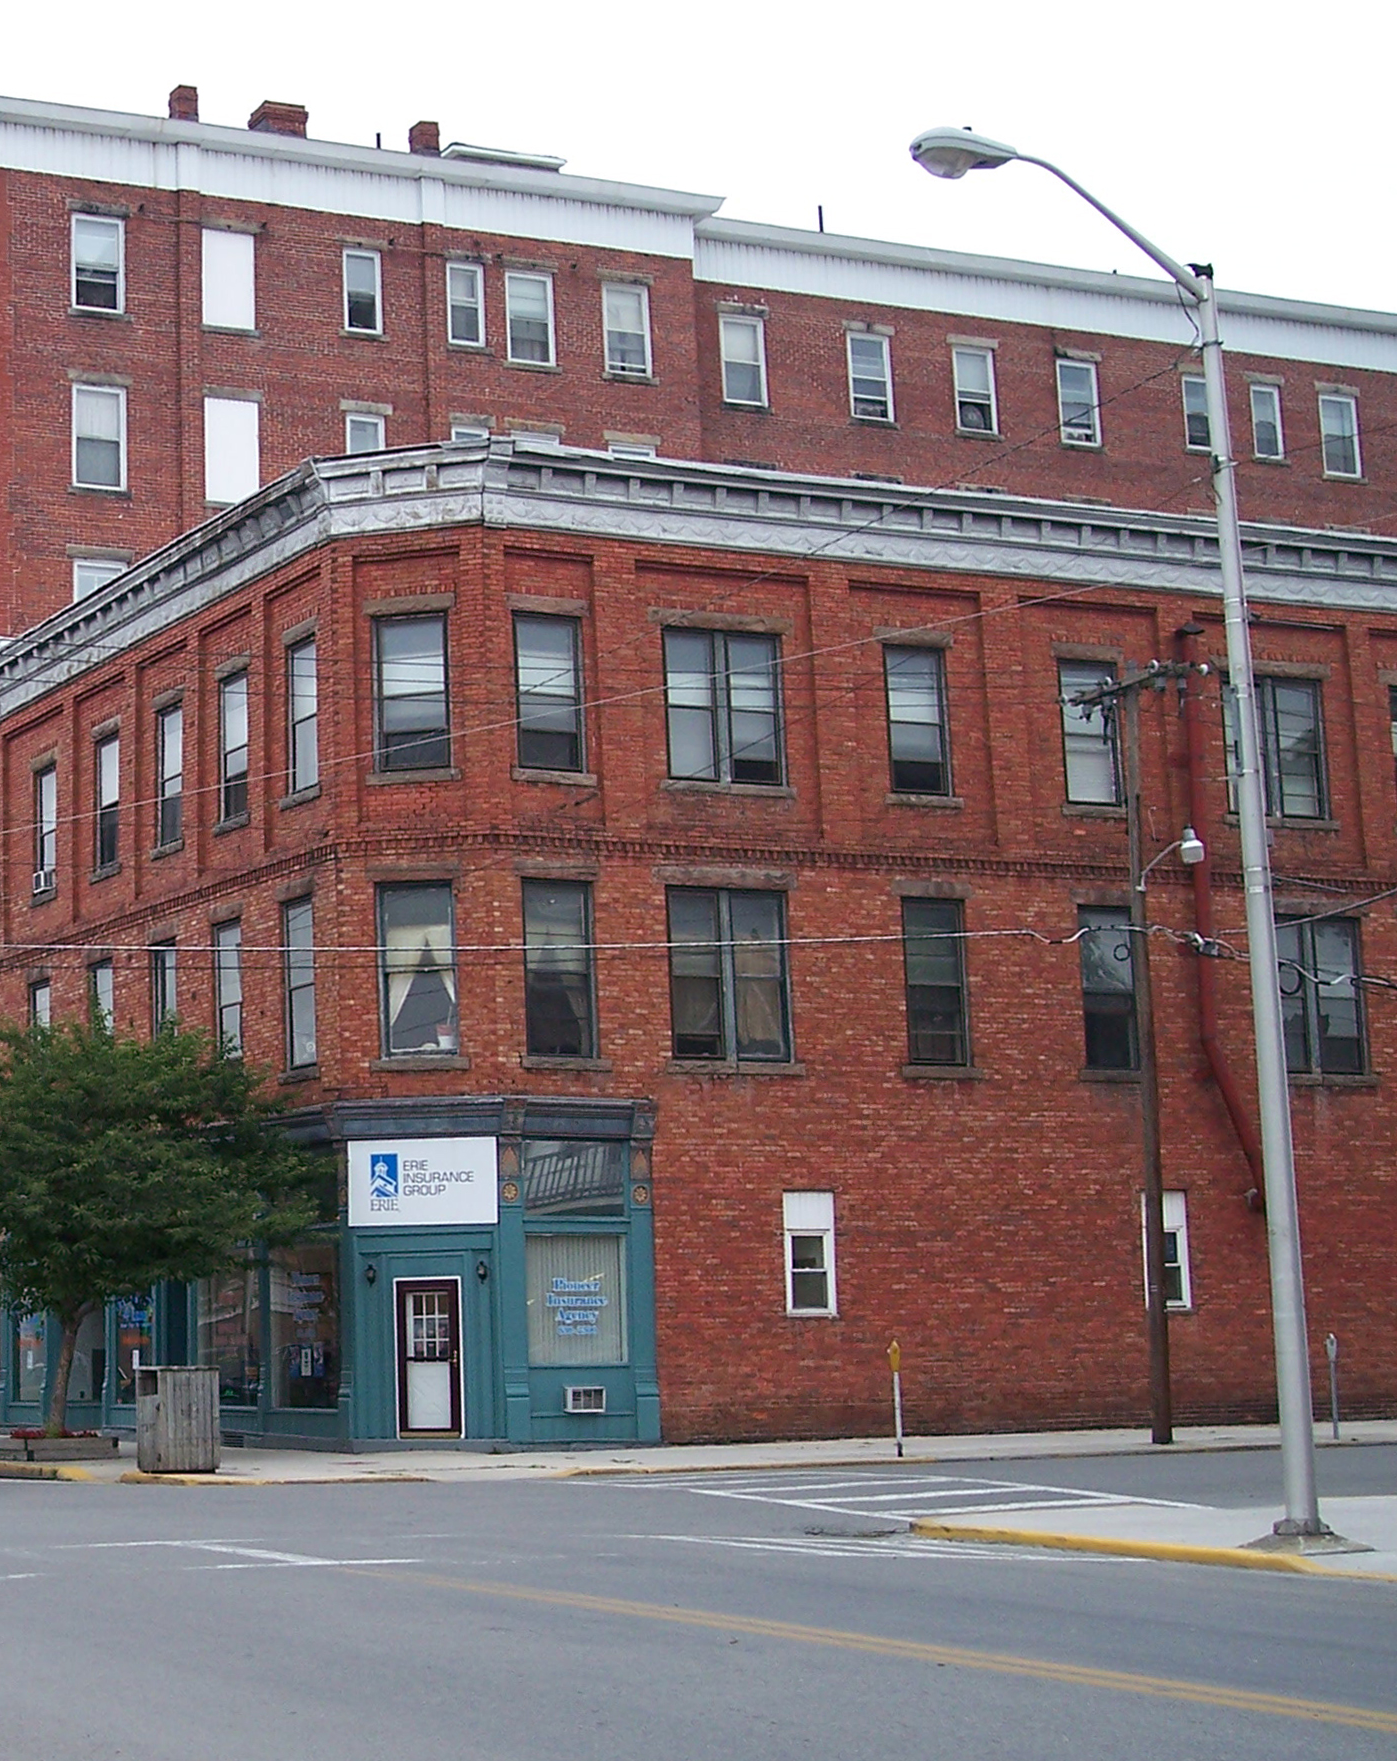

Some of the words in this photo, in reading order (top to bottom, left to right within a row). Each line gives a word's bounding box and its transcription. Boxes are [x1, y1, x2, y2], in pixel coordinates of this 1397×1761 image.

[402, 1160, 429, 1171] ERIE
[402, 1171, 475, 1184] INSURANCE
[402, 1184, 447, 1196] GROUP
[370, 1198, 399, 1212] ERIE
[553, 1277, 600, 1291] Pioneer
[546, 1292, 608, 1307] Insurance
[555, 1307, 599, 1324] Agency
